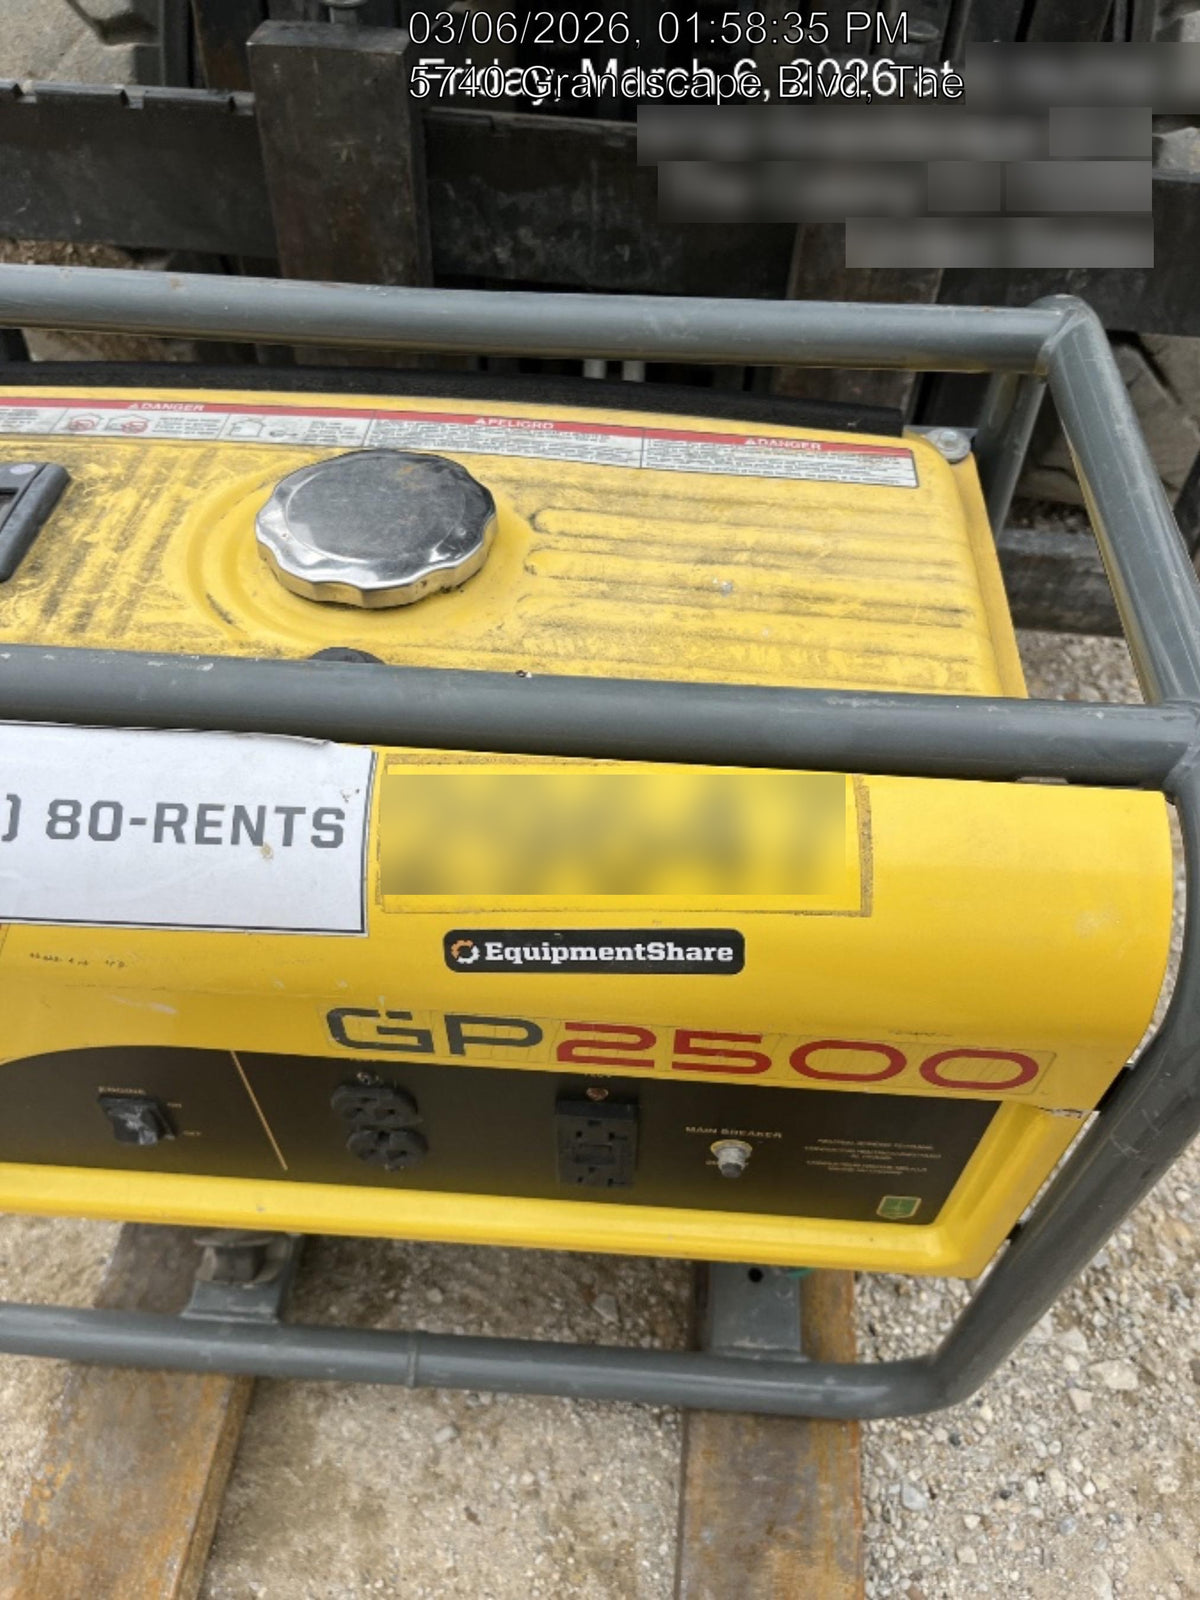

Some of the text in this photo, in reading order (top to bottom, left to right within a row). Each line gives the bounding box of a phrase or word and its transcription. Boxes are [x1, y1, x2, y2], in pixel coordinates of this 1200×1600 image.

[141, 402, 205, 412] DANGER
[757, 438, 822, 450] DANGER
[45, 799, 346, 849] 80-RENTS
[484, 941, 734, 965] EquipmentShare
[326, 1007, 1039, 1091] GP2500
